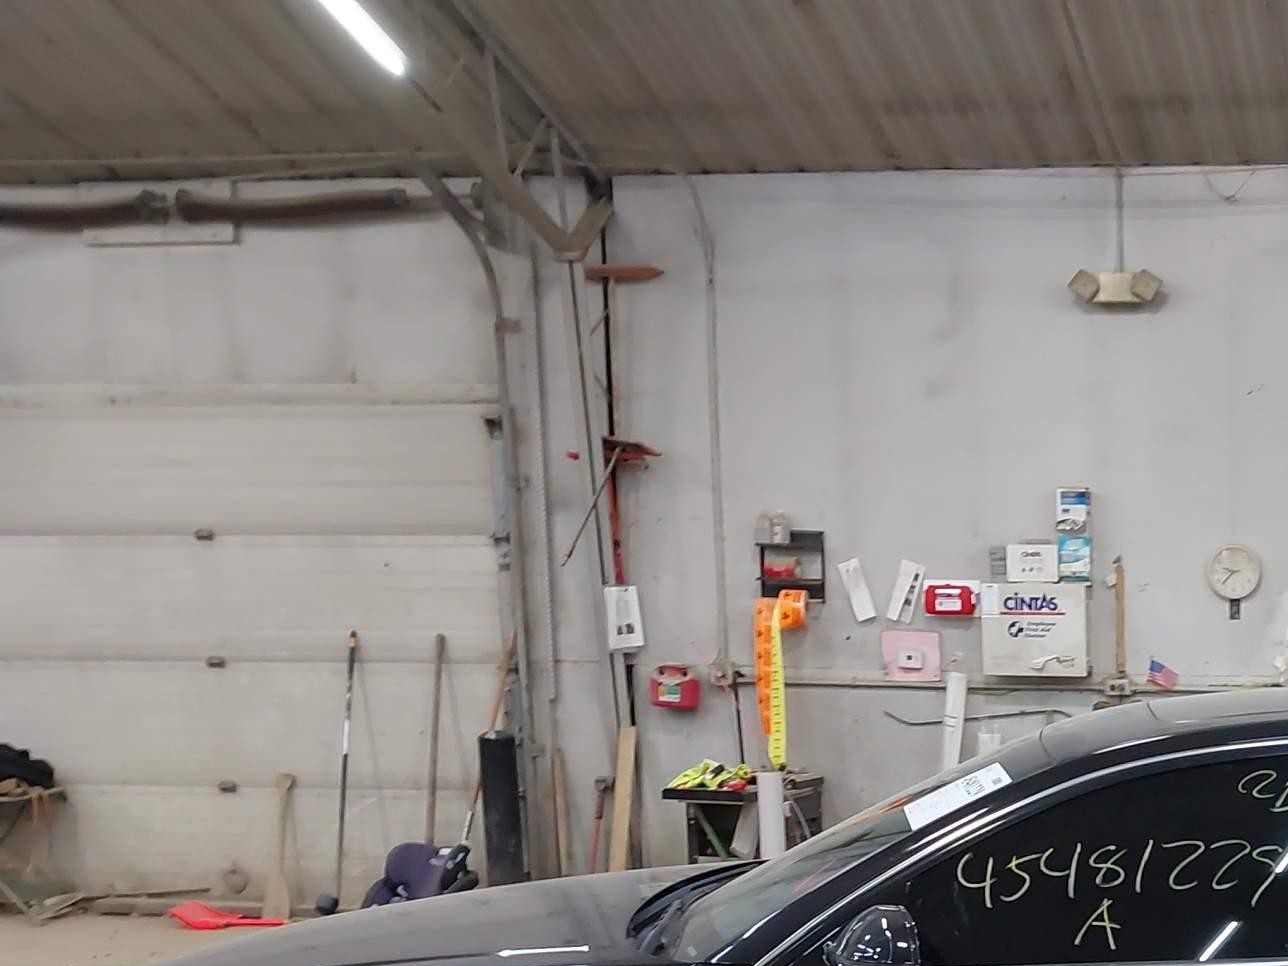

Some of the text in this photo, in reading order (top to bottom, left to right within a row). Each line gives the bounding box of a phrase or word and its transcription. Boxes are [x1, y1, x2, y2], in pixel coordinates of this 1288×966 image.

[1003, 592, 1058, 611] CINTAS
[956, 839, 1284, 908] 45481229
[1074, 898, 1121, 950] A
